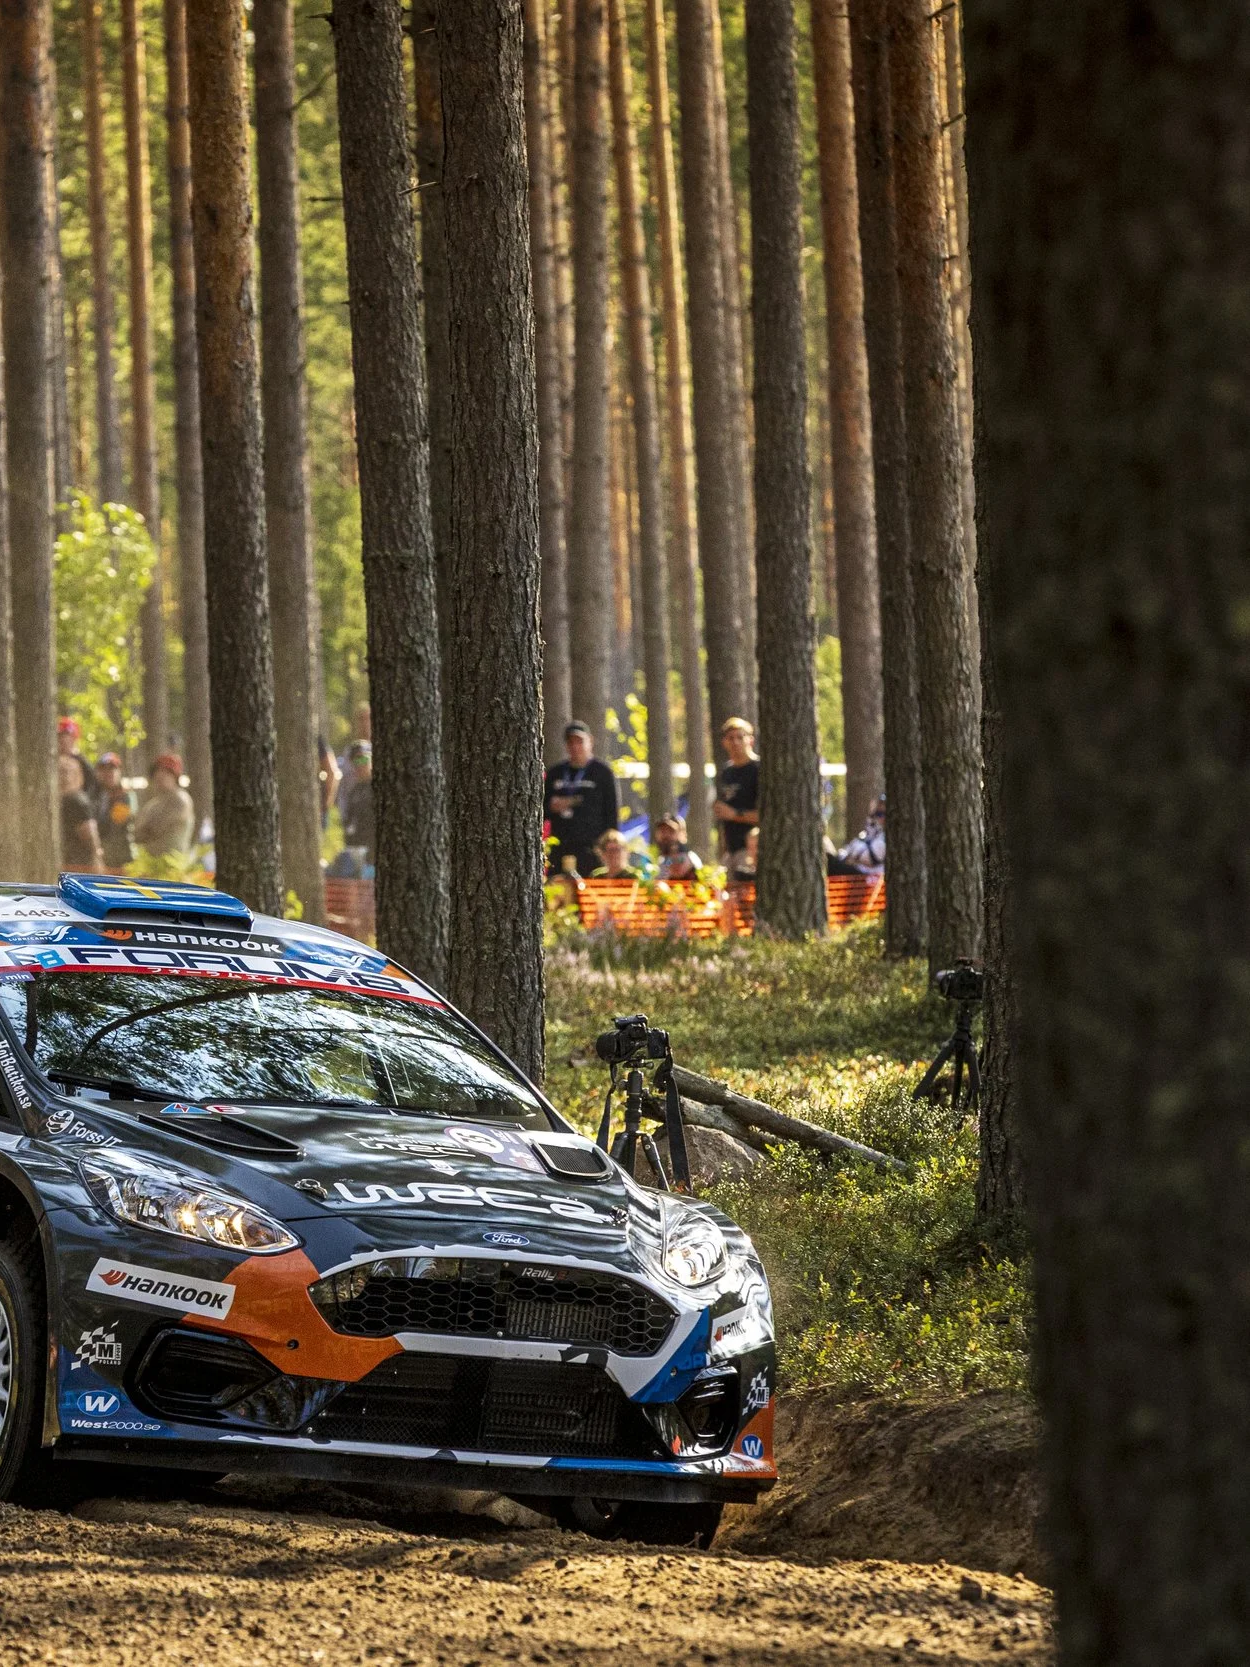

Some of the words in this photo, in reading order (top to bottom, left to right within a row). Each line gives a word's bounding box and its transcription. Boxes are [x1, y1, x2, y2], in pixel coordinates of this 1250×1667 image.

[146, 966, 298, 984] フォーラムエイト
[68, 1120, 105, 1144] Forss
[100, 1135, 123, 1148] IT
[491, 1233, 523, 1244] Ford
[84, 1395, 118, 1413] W
[70, 1419, 162, 1431] West2000.se
[743, 1440, 762, 1457] W
